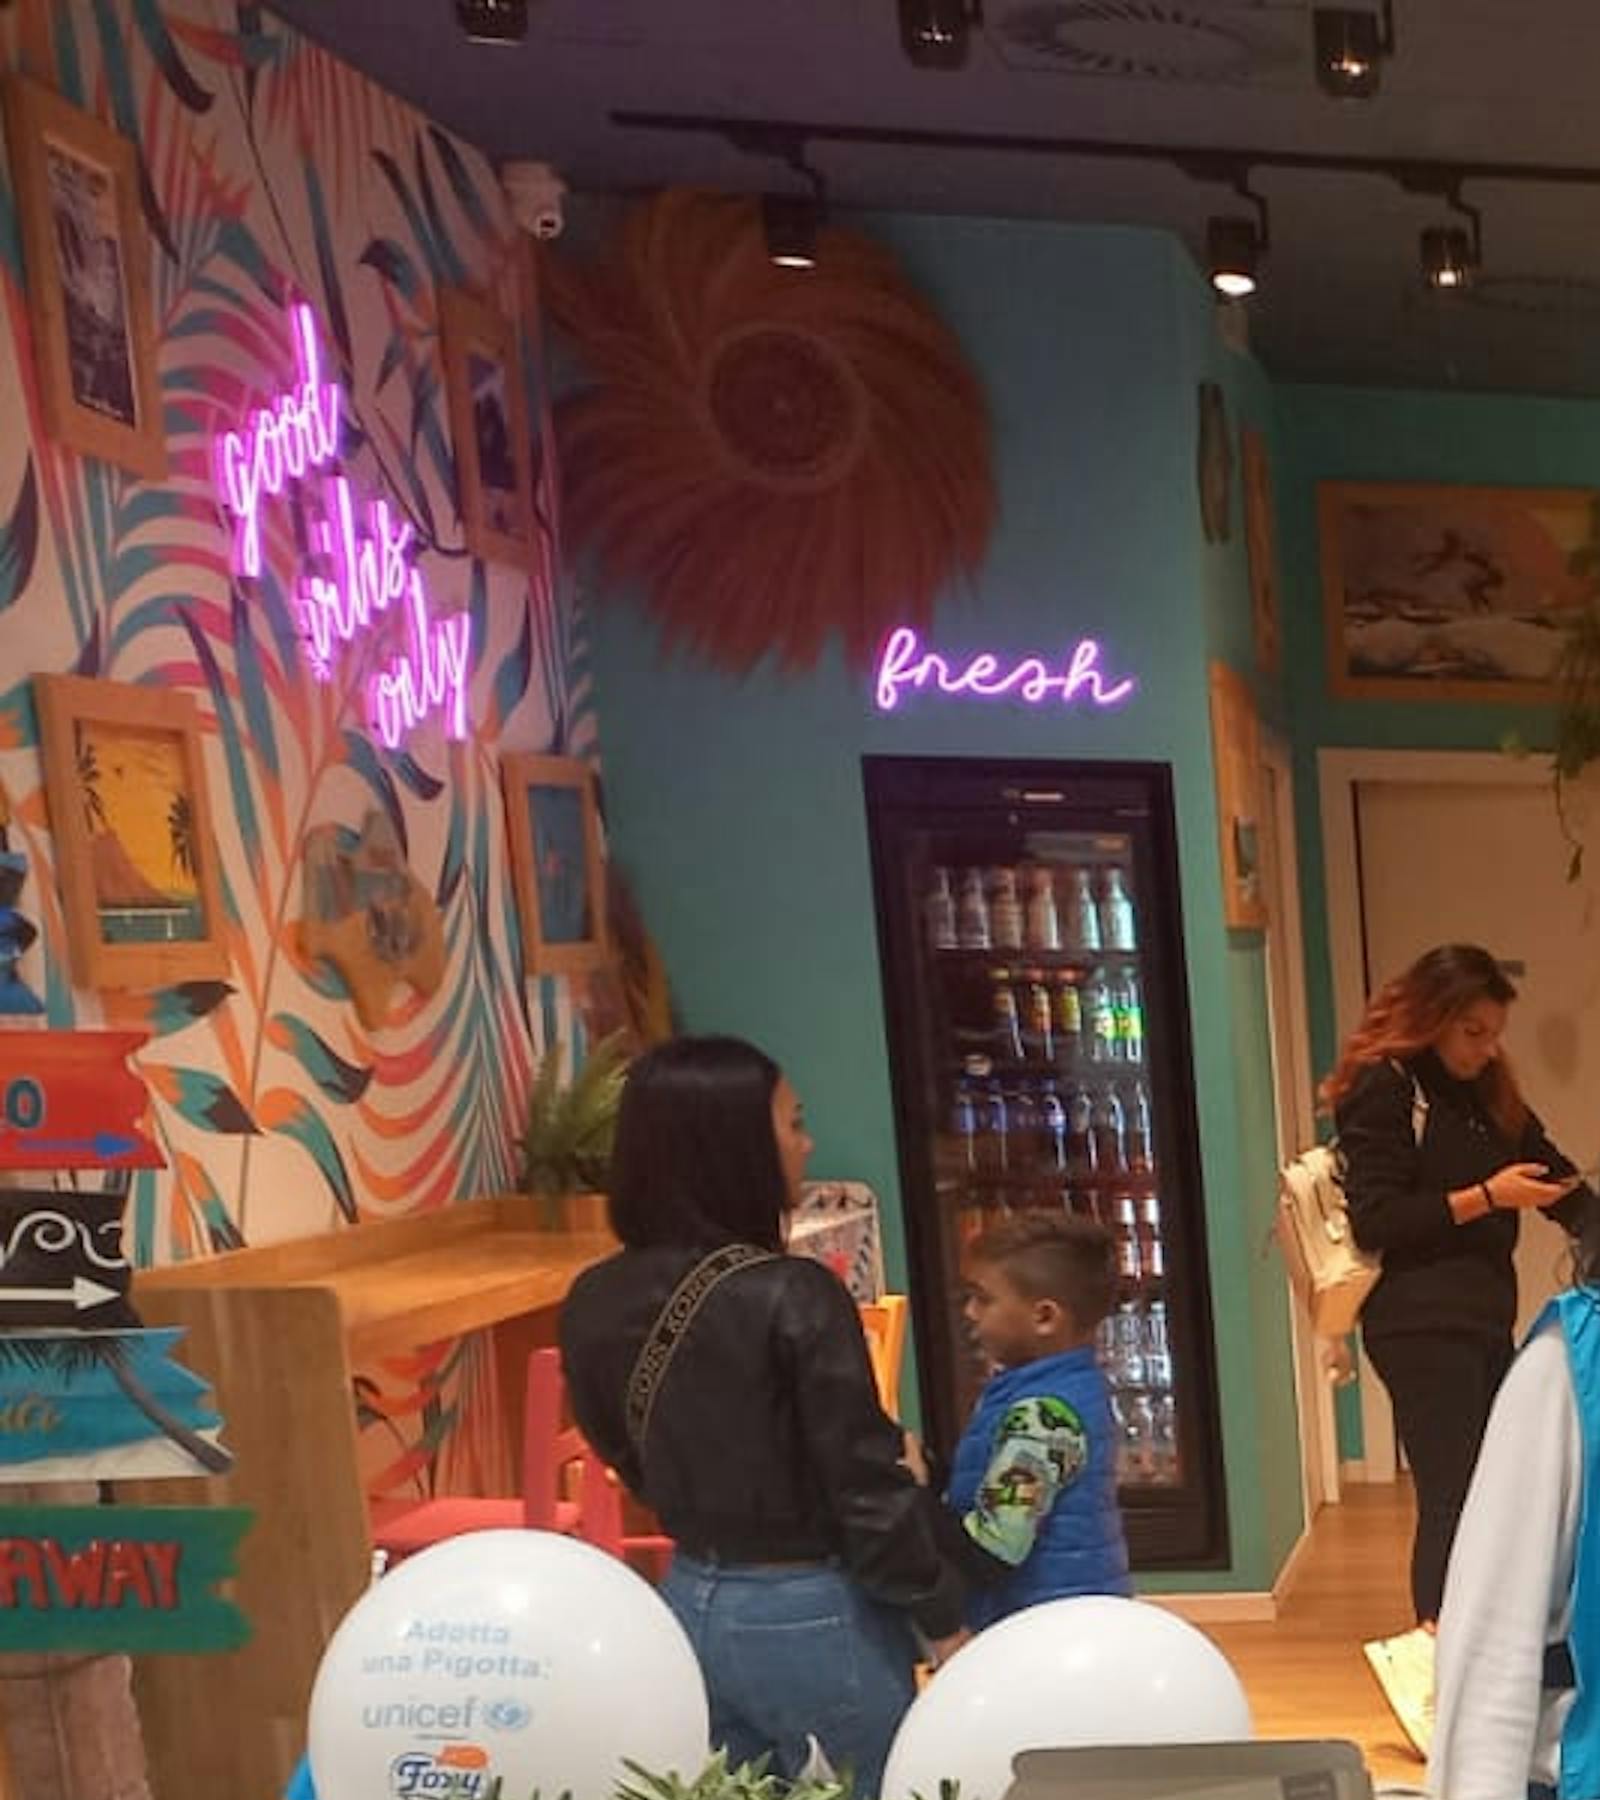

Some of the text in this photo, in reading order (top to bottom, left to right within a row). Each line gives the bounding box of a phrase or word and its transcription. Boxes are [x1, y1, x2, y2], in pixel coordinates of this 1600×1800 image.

[217, 303, 341, 577] good
[372, 573, 470, 748] only
[876, 627, 1135, 710] fresh
[404, 1618, 511, 1646] Adotta
[362, 1655, 413, 1675] una
[362, 1695, 478, 1730] unicef
[397, 1758, 482, 1795] Foxy
